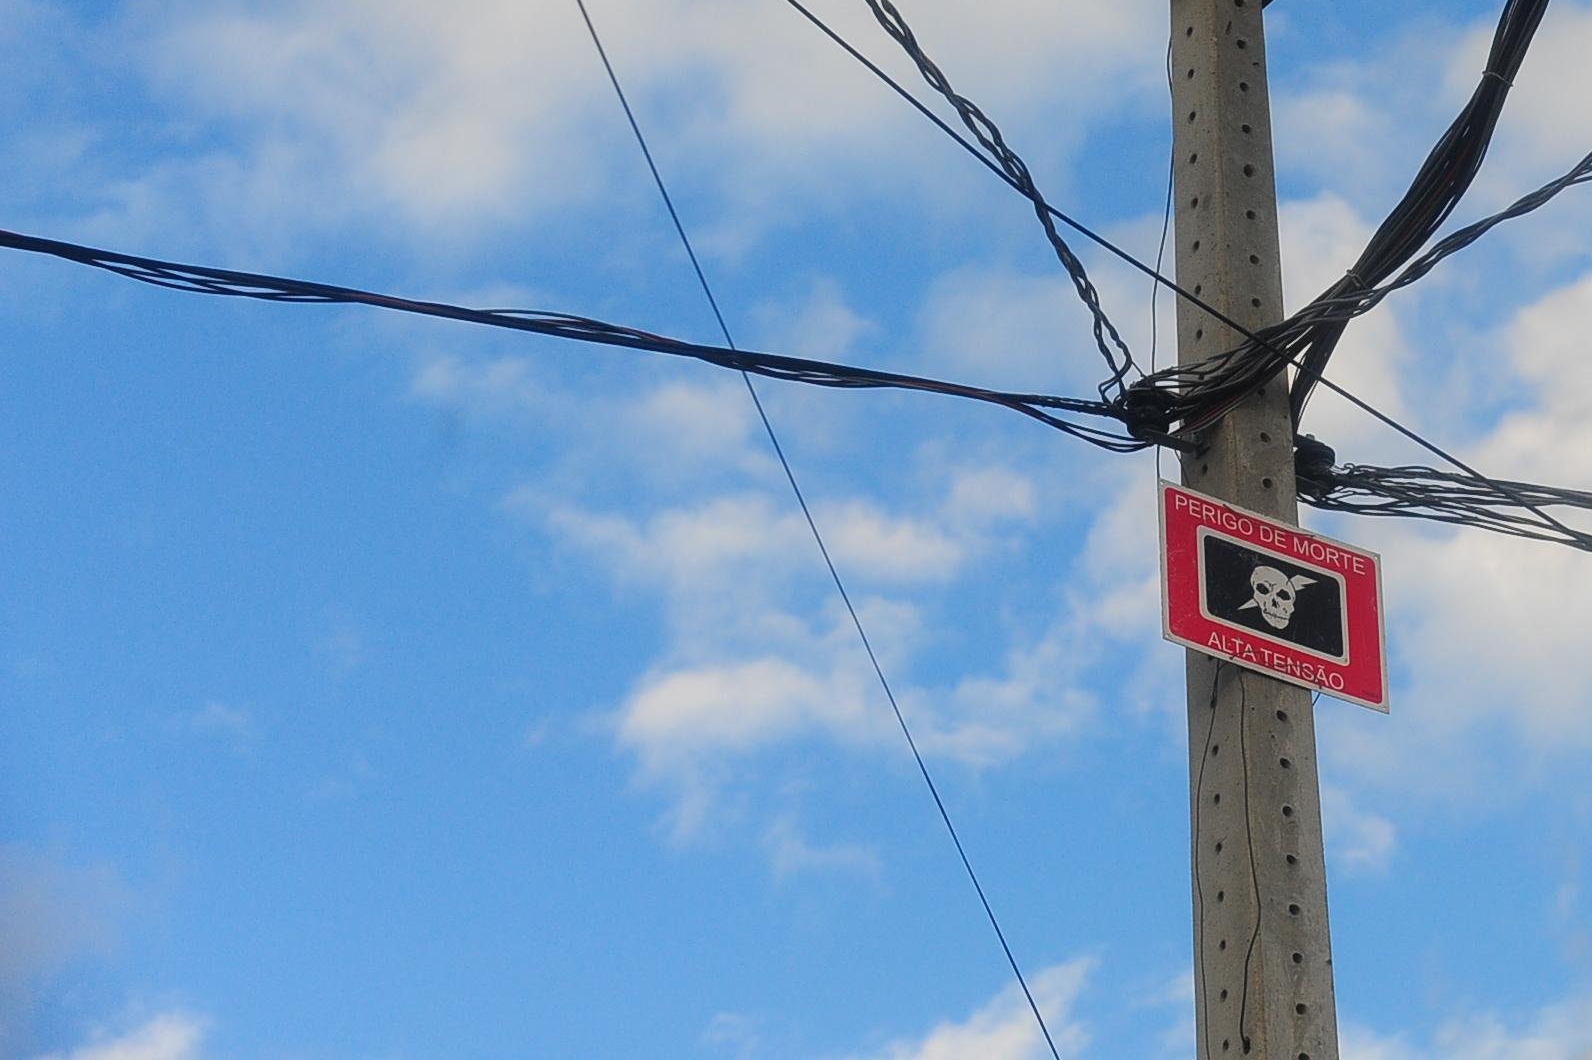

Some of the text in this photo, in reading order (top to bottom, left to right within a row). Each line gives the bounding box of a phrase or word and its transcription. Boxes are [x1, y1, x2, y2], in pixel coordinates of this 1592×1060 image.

[1175, 494, 1366, 575] PERIGO DE MORTE
[1207, 631, 1344, 690] ALTA TENSÃO
